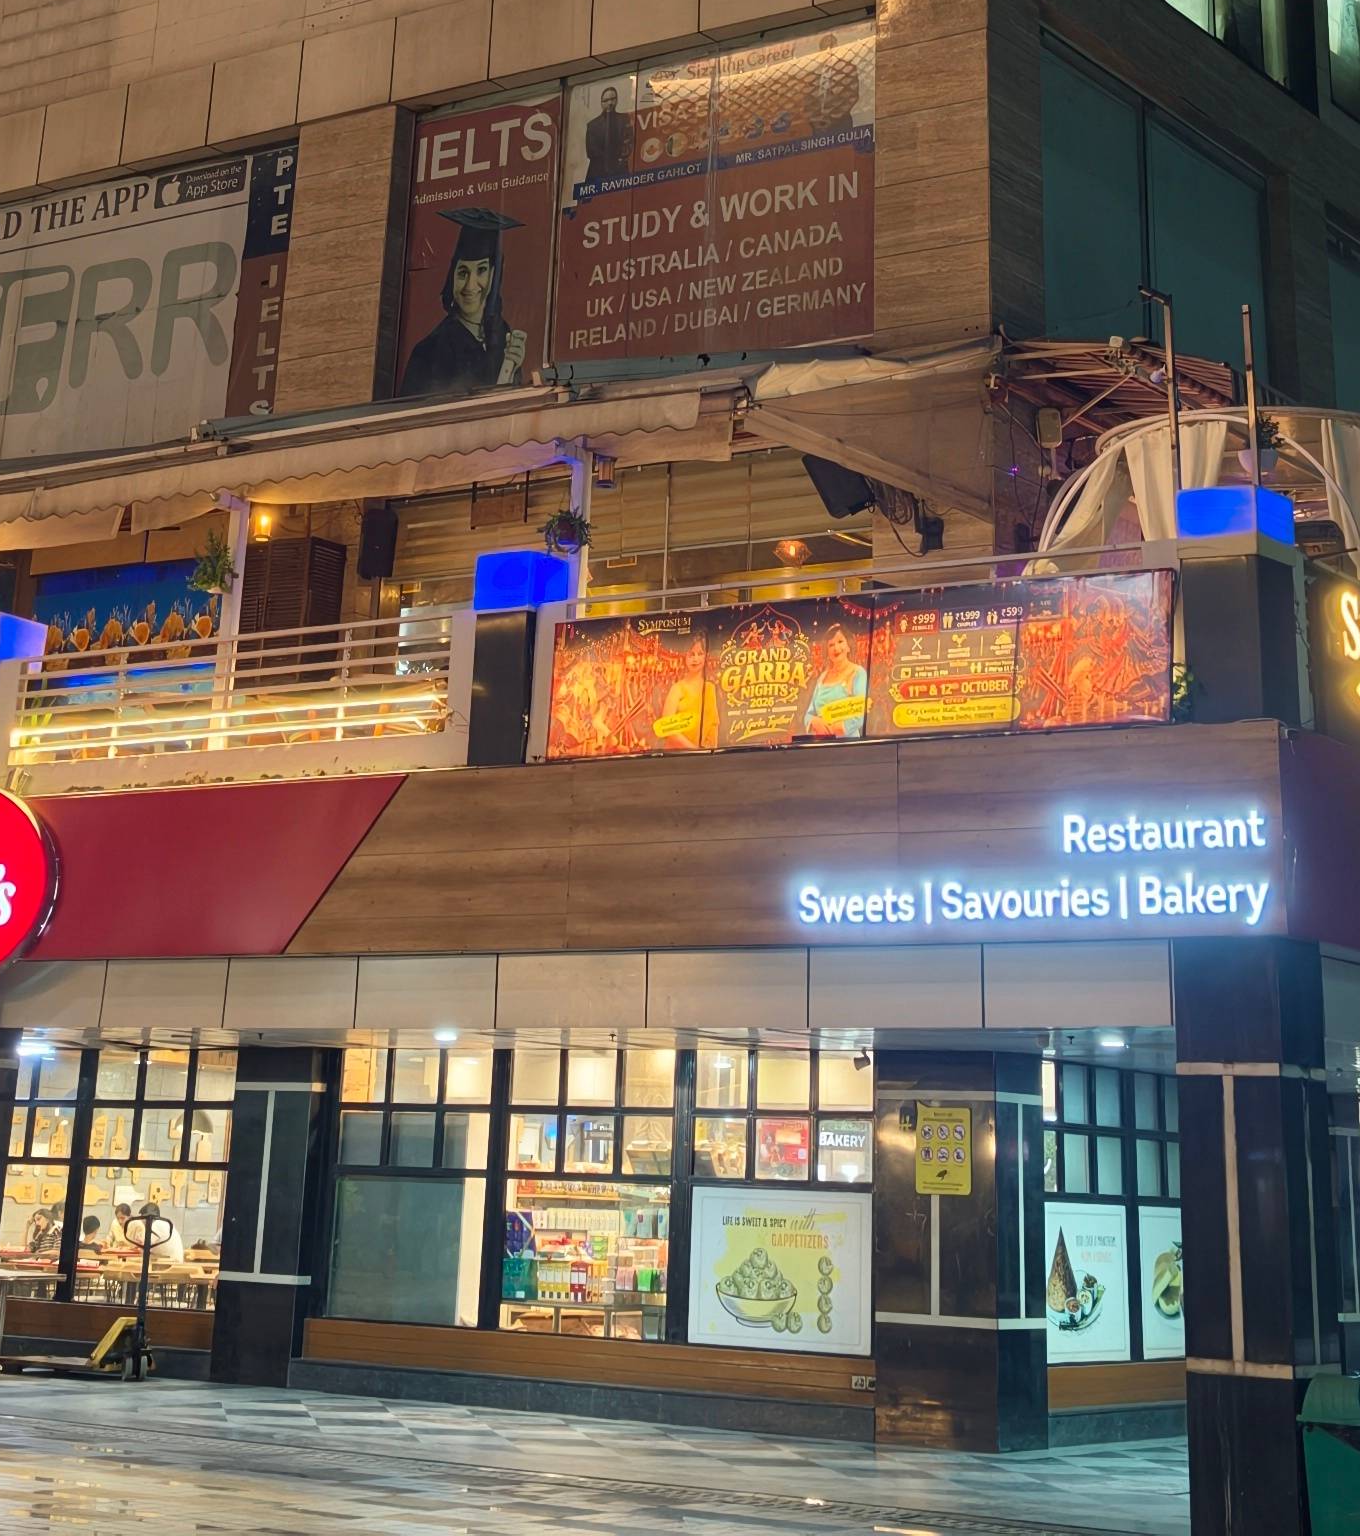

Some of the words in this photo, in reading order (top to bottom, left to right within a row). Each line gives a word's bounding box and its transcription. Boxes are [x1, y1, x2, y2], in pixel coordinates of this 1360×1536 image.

[747, 47, 795, 69] Career
[417, 112, 552, 183] IELTS
[735, 150, 754, 164] MR.
[801, 134, 835, 151] SINGH
[837, 128, 872, 144] GULIA
[186, 169, 219, 185] Download
[186, 184, 208, 200] App
[210, 177, 238, 193] Store
[467, 184, 475, 196] &
[477, 180, 499, 194] Visa
[579, 183, 597, 196] MR.
[601, 171, 655, 193] RAVINDER
[658, 163, 703, 181] GAHLOT
[30, 195, 87, 235] THE
[91, 182, 150, 221] APP
[582, 205, 683, 249] STUDY
[690, 200, 710, 229] &
[720, 178, 819, 223] WORK
[829, 171, 859, 204] IN
[588, 242, 720, 287] AUSTRALIA
[739, 221, 844, 259] CANADA
[586, 295, 613, 319] UK
[631, 288, 672, 312] USA
[689, 274, 737, 300] NEW
[741, 256, 844, 292] ZEALAND
[569, 318, 657, 350] IRELAND
[674, 304, 738, 334] DUBAI
[757, 282, 867, 319] GERMANY
[734, 648, 791, 665] GRAND
[721, 662, 808, 693] GARBA
[741, 683, 790, 699] NIGHTS
[961, 680, 1009, 694] OCTOBER
[1063, 809, 1266, 854] Restaurant
[798, 885, 915, 923] Sweets
[940, 879, 1110, 921] Savouries
[1138, 871, 1269, 925] Bakery
[819, 1132, 866, 1148] BAKERY
[742, 1216, 761, 1228] SWEET
[769, 1218, 787, 1229] SPICY
